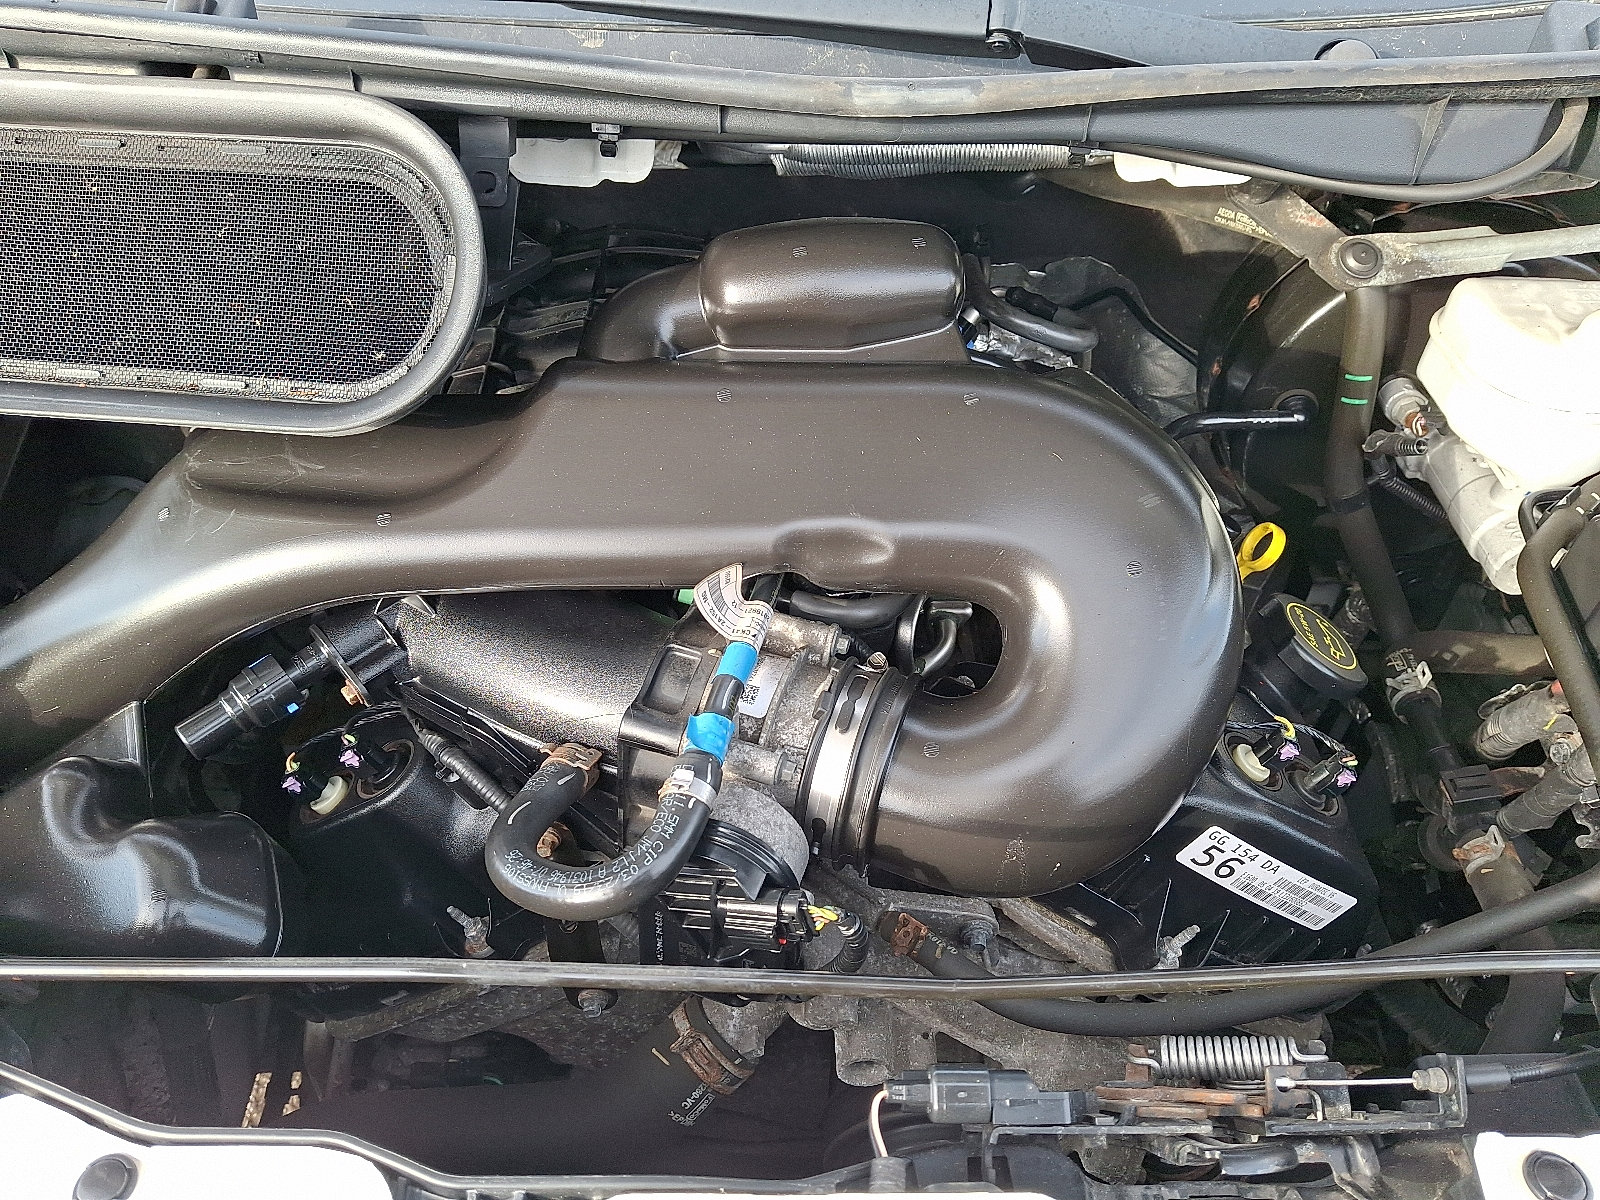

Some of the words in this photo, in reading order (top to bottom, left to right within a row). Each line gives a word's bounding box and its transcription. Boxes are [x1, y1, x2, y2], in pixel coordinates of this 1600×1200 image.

[644, 840, 663, 866] CIP
[1190, 844, 1246, 878] 56
[1208, 831, 1230, 846] GG
[1231, 843, 1260, 863] 154
[1260, 859, 1281, 875] DA
